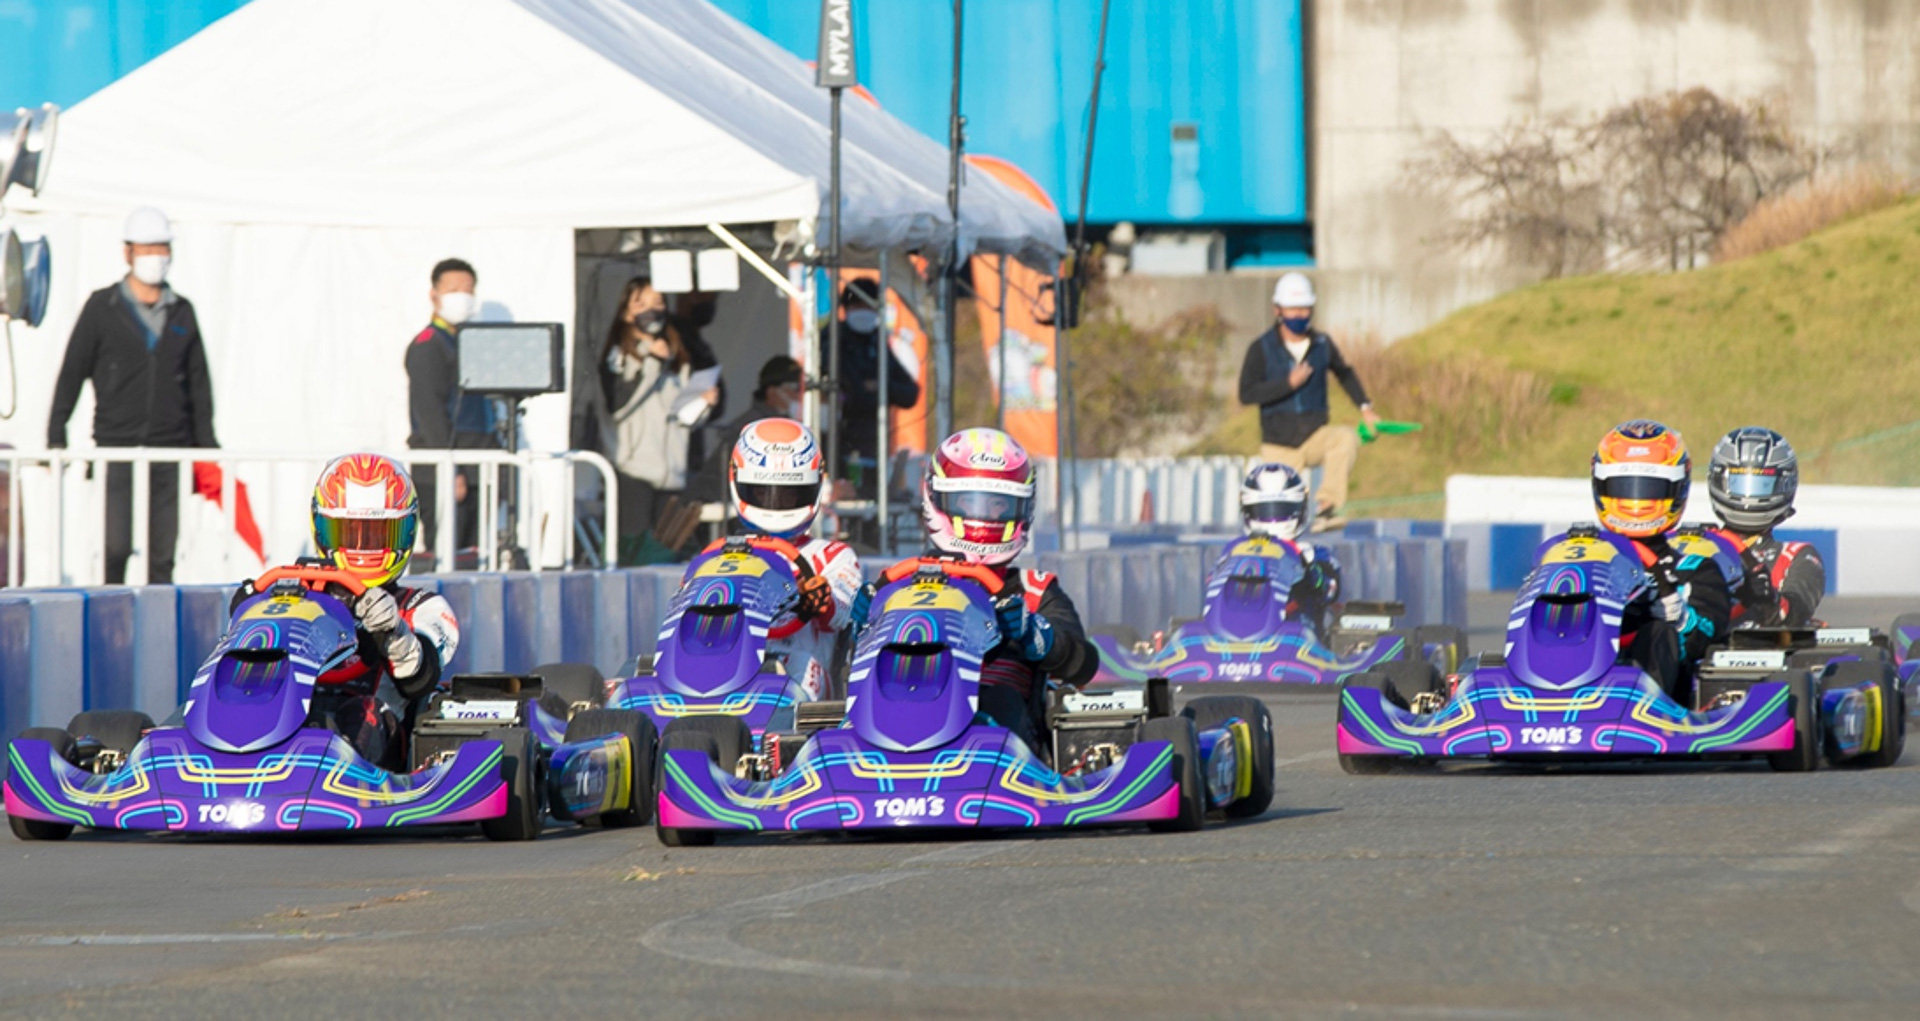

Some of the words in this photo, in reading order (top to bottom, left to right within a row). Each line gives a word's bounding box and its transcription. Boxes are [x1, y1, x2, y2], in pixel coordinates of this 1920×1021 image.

[1247, 545, 1263, 554] 4
[1563, 546, 1587, 560] 3
[716, 561, 739, 573] 5
[910, 592, 938, 606] 2
[262, 603, 292, 615] 8
[1520, 725, 1583, 745] TOM'S
[198, 802, 266, 823] TOM'S
[874, 795, 946, 818] TOM'S
